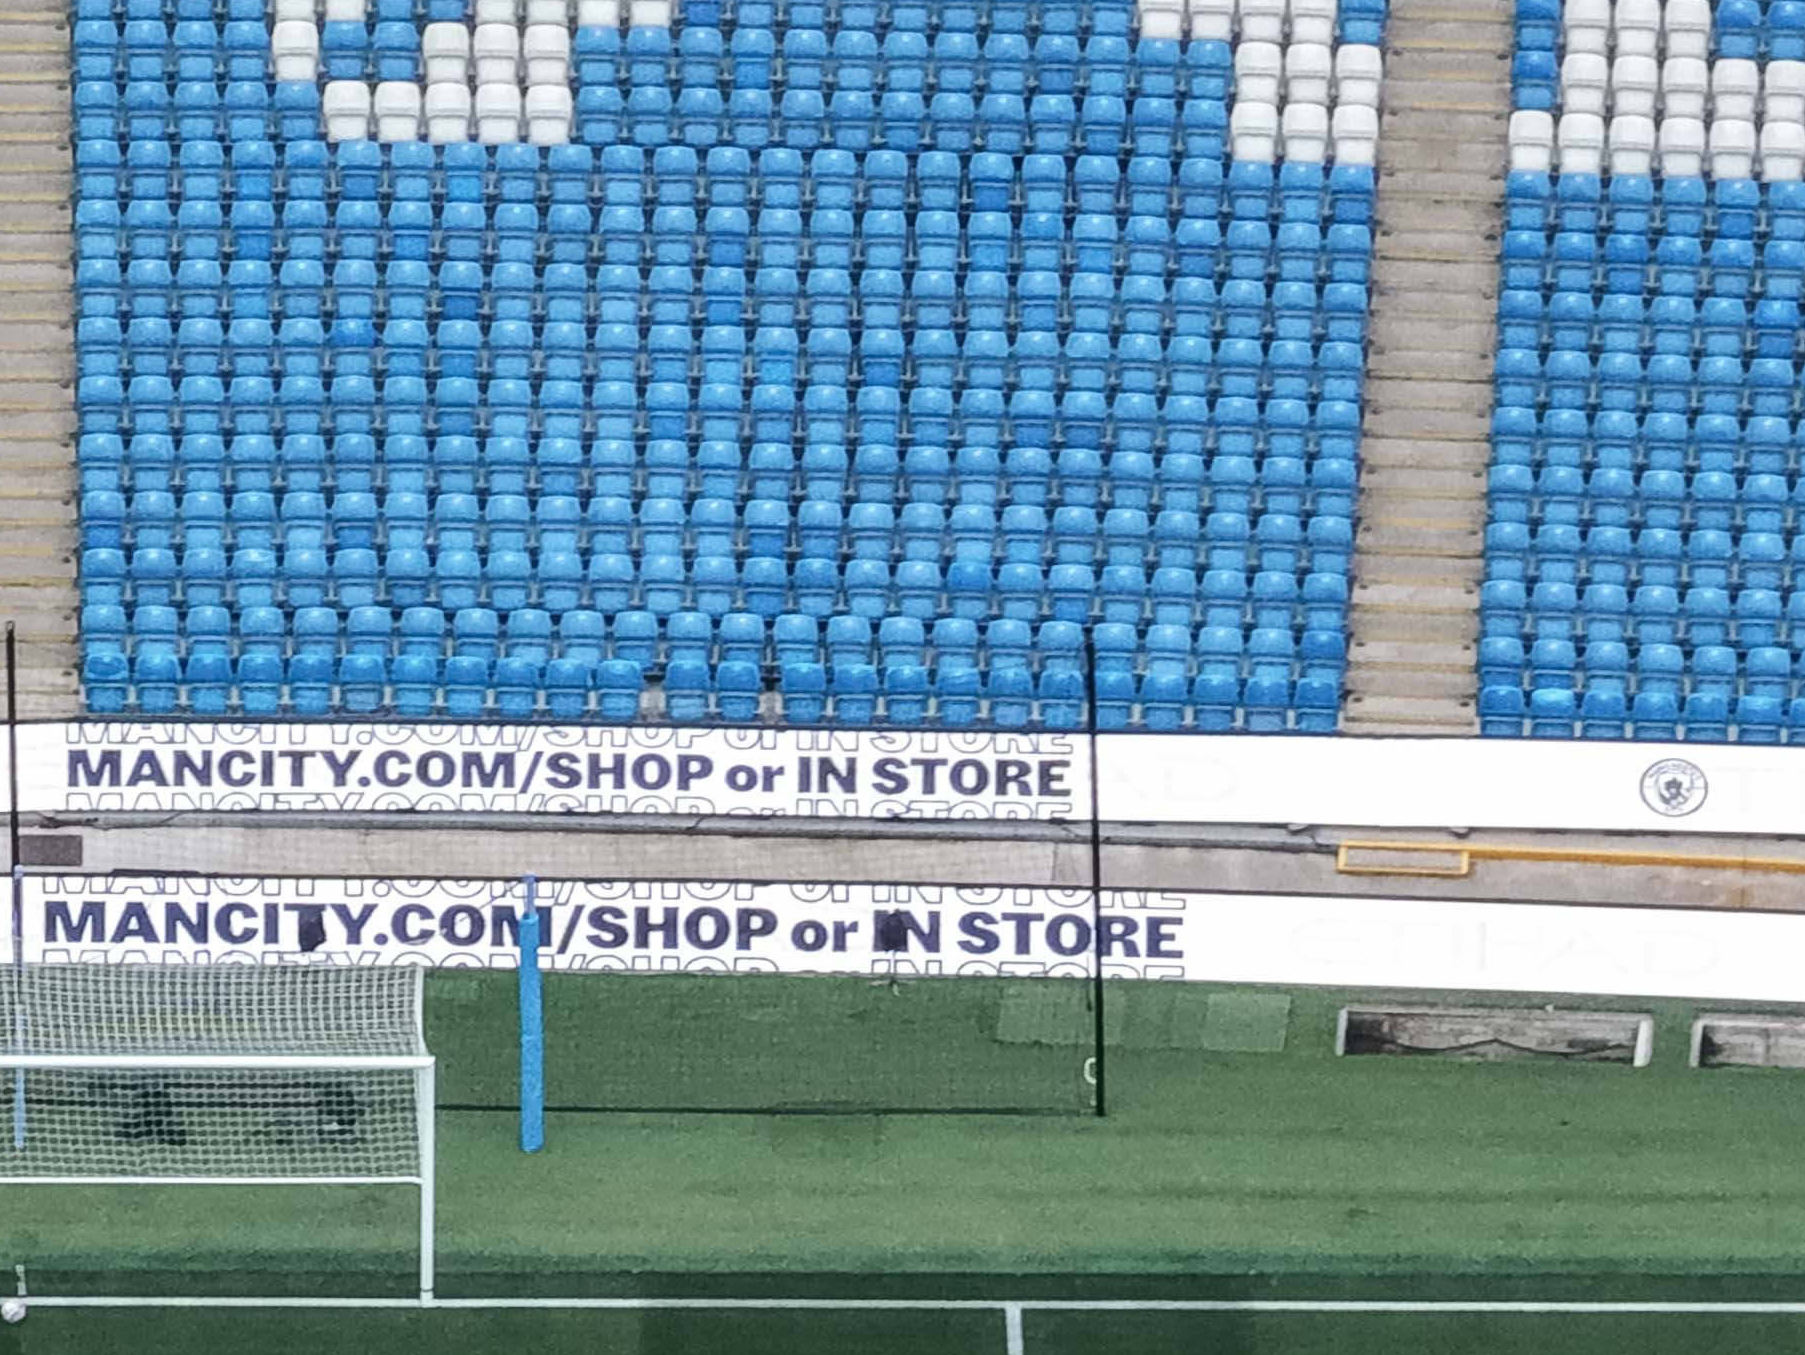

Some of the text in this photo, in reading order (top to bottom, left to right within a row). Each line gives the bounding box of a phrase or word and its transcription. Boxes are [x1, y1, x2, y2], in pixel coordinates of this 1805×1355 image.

[68, 749, 715, 795] MANCITY.COM/SHOP
[726, 765, 786, 794] or
[798, 756, 859, 796] IN
[873, 757, 1073, 799] STORE
[791, 920, 859, 953] or
[957, 911, 1184, 960] STORE
